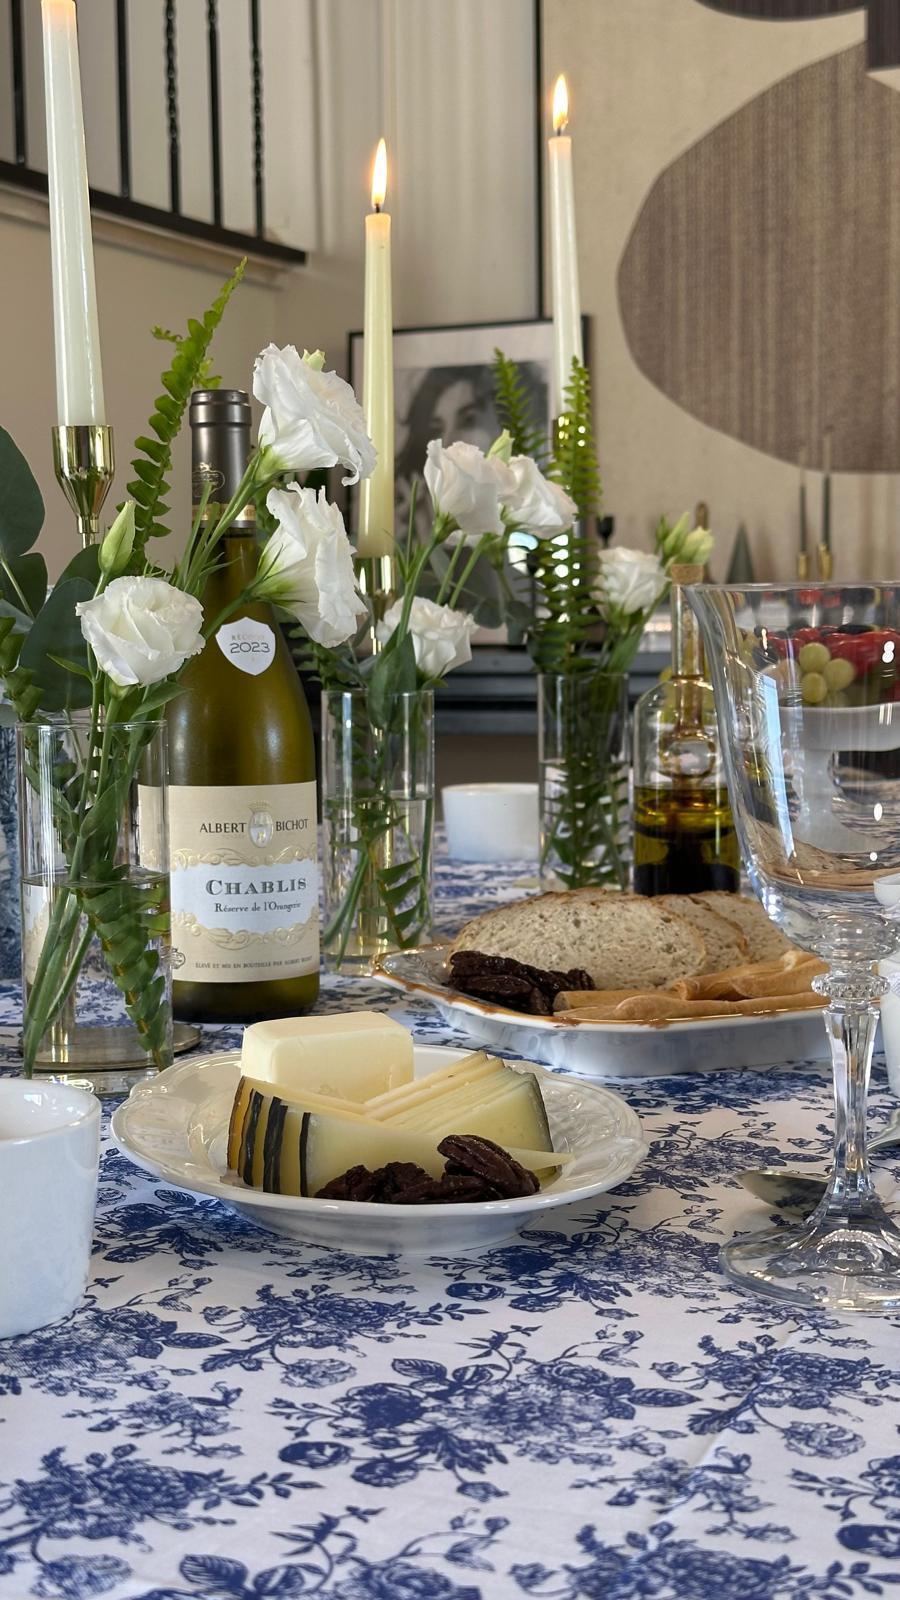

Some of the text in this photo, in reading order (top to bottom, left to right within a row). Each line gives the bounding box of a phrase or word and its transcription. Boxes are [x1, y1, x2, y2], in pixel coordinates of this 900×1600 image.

[229, 641, 271, 654] 2023
[199, 818, 309, 833] ALBERT BICHOT
[213, 901, 249, 913] Réserve
[251, 901, 261, 912] de
